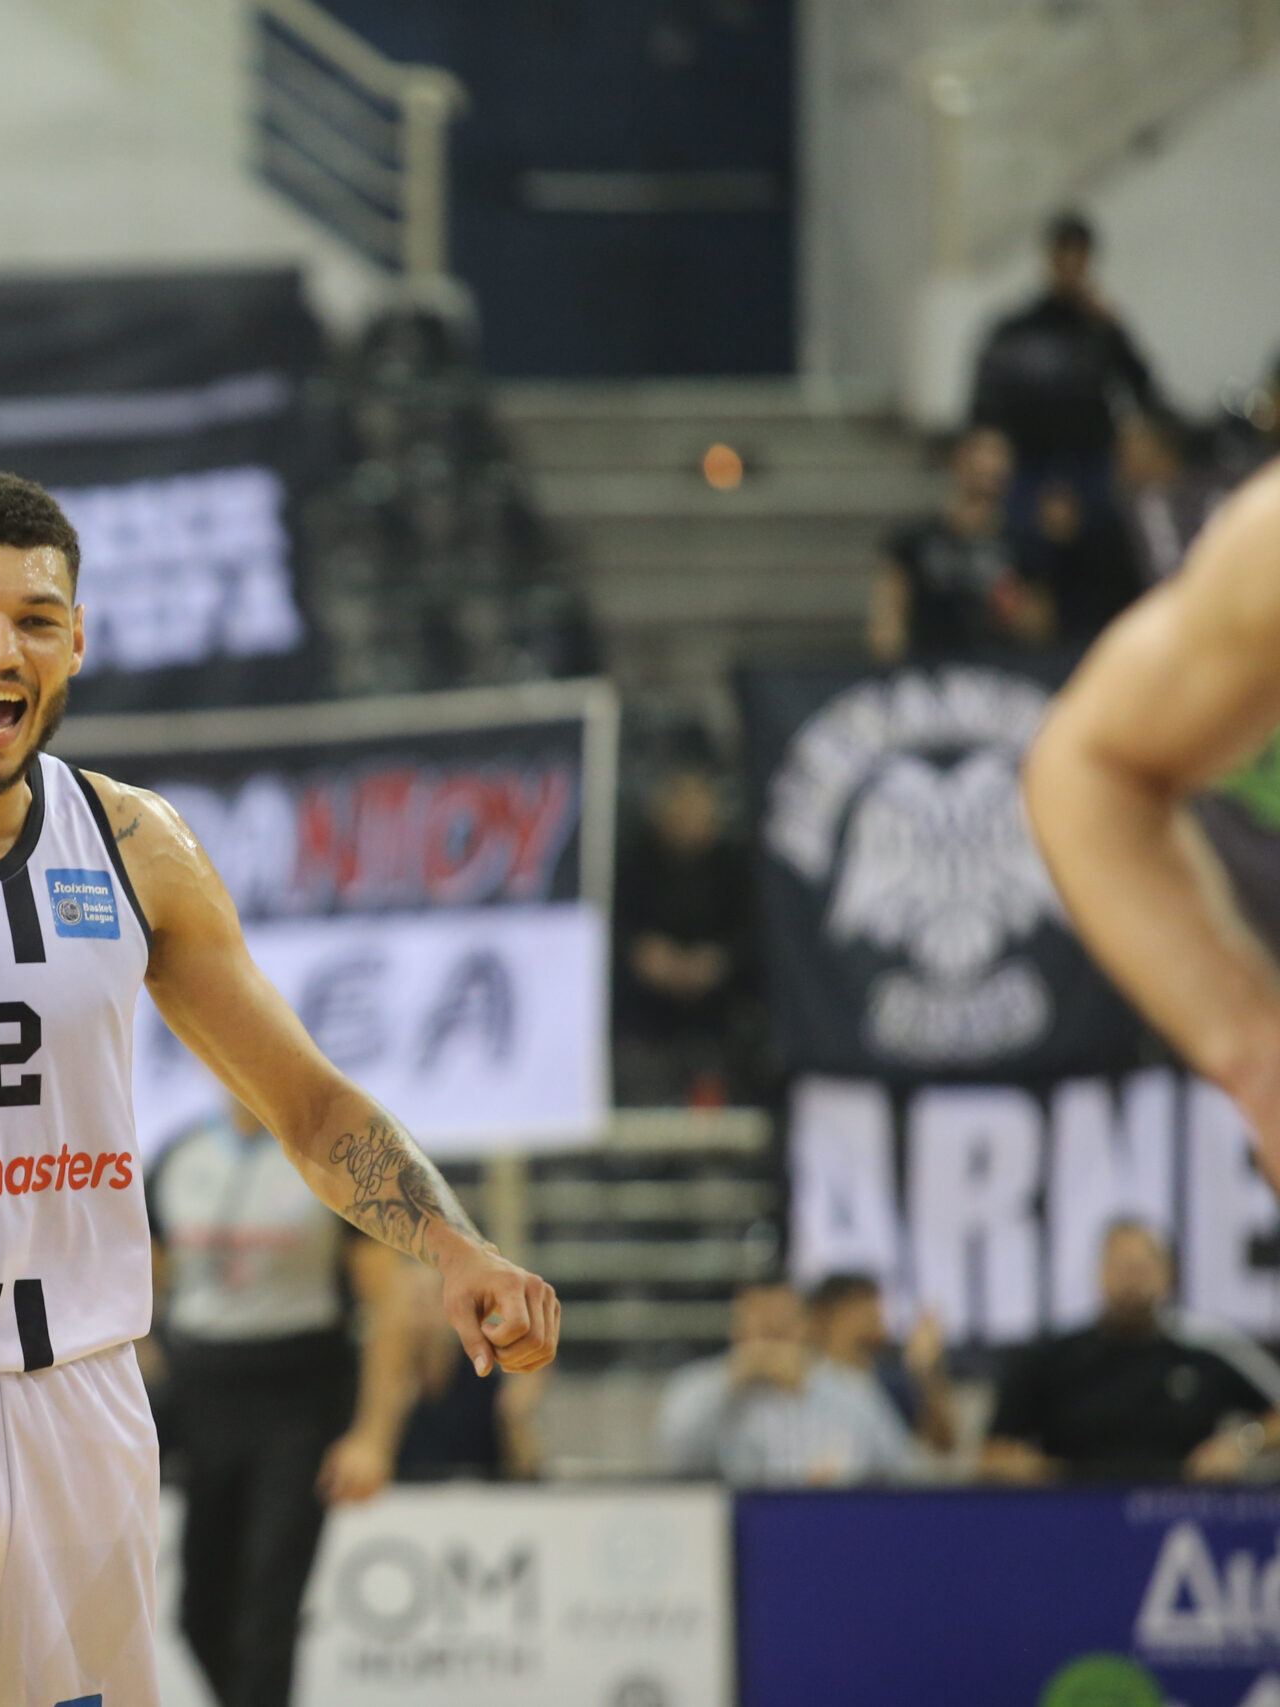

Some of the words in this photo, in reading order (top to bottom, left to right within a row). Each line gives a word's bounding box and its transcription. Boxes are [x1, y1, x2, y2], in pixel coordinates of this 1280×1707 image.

[53, 881, 109, 896] Stoiximan
[82, 902, 113, 914] Basket
[84, 912, 115, 924] League
